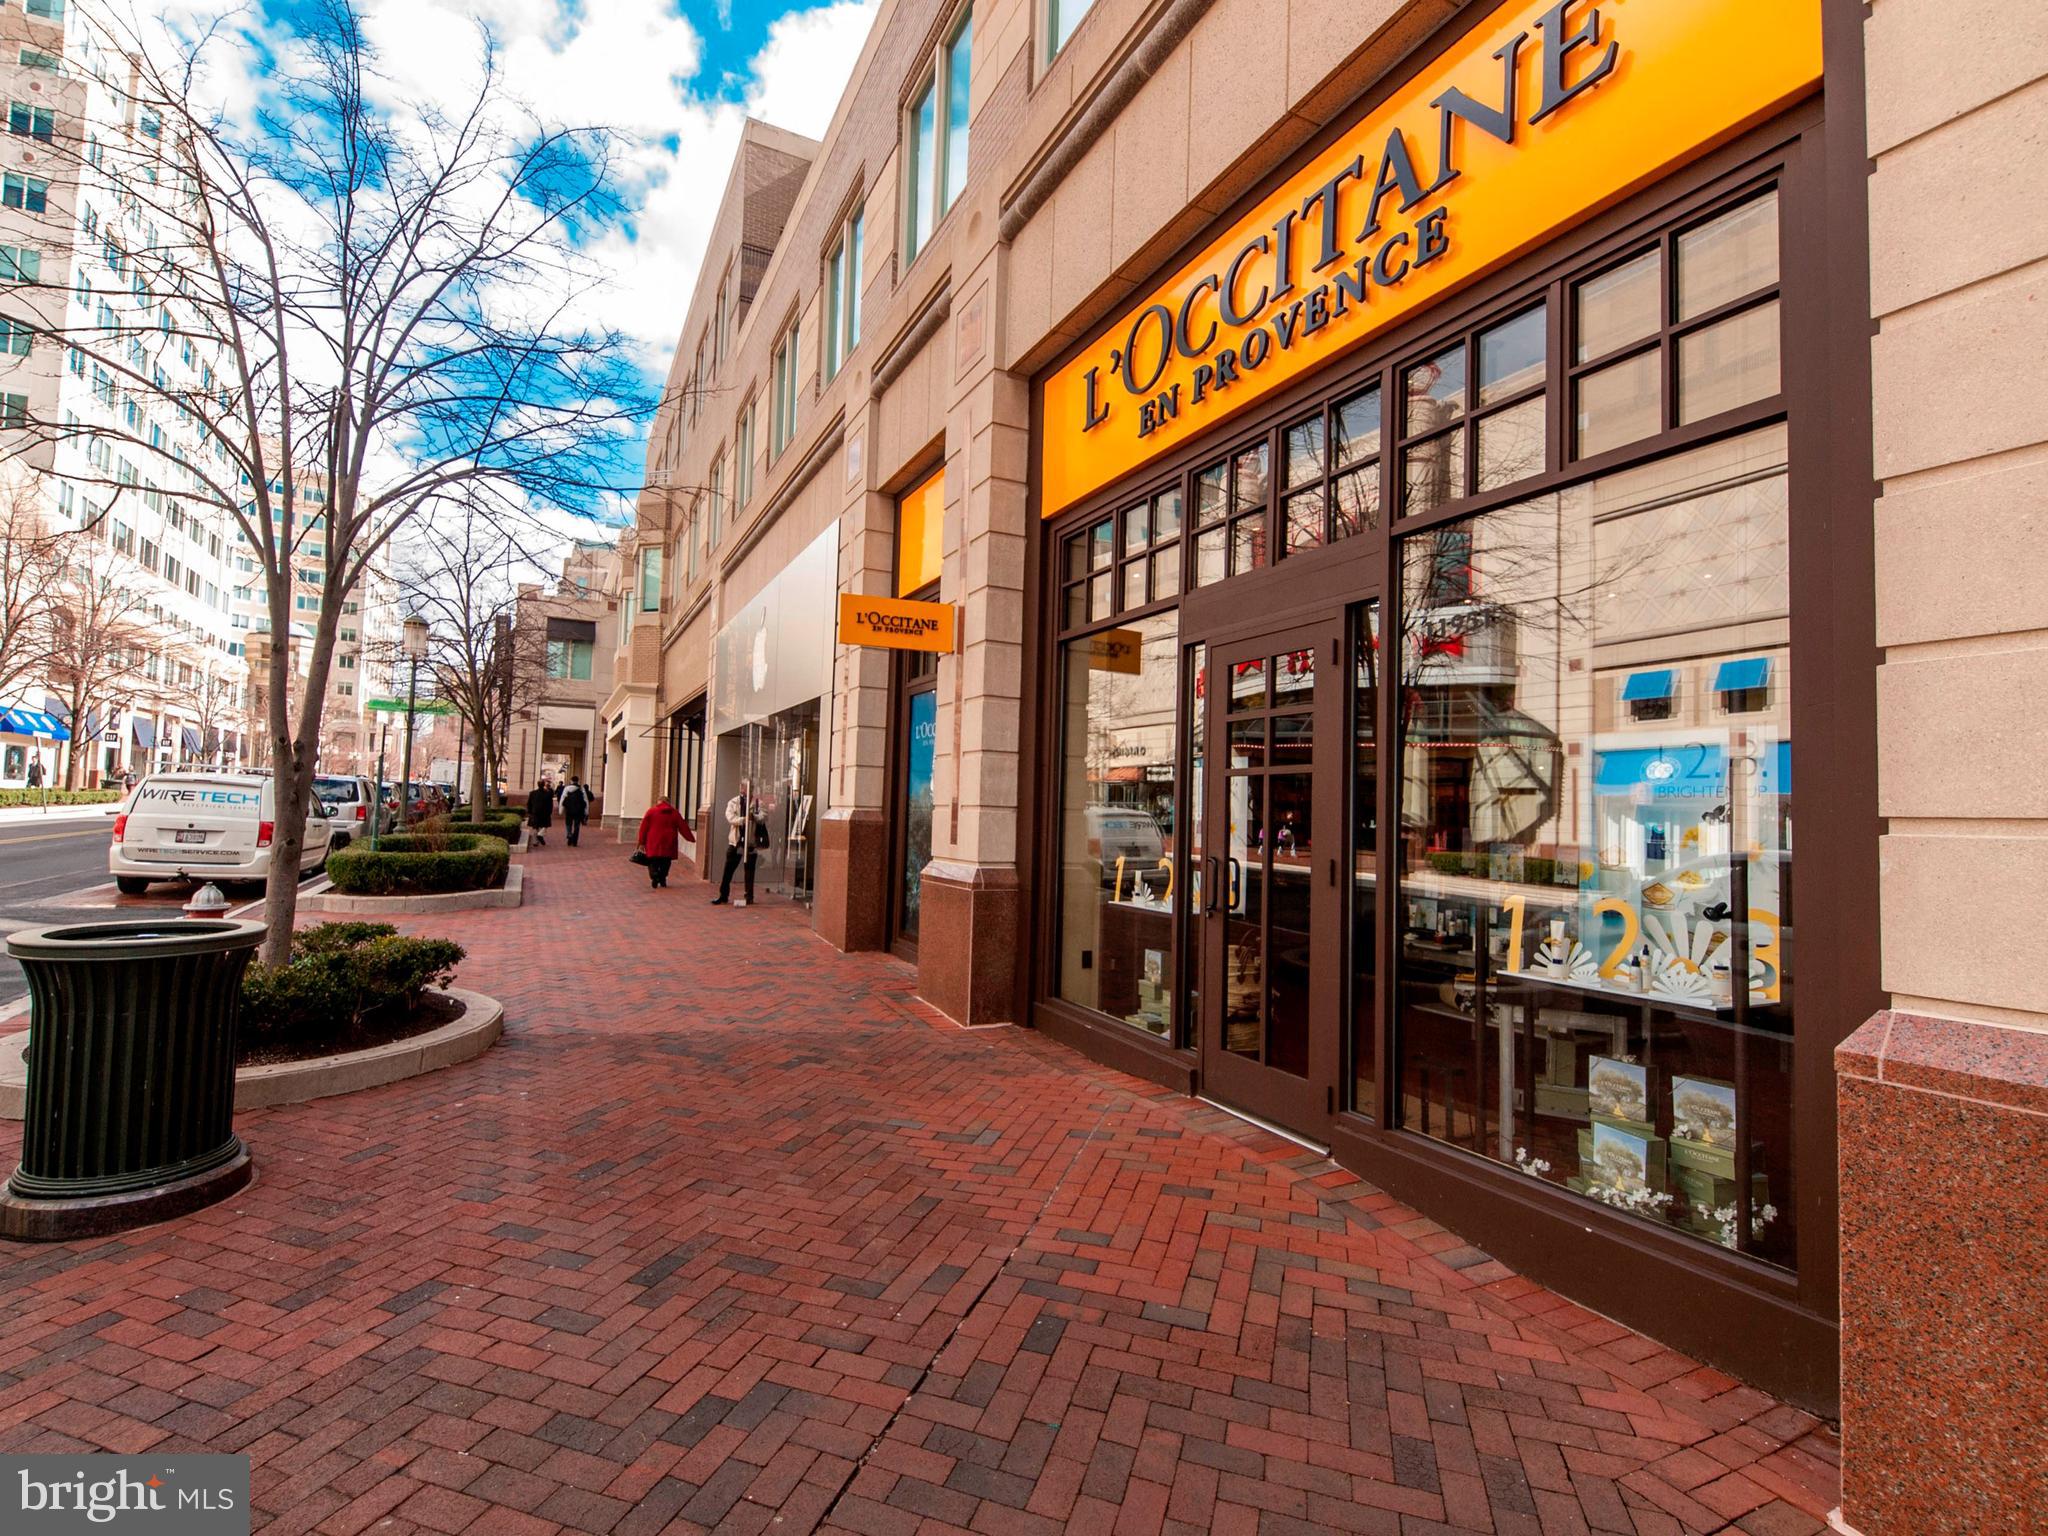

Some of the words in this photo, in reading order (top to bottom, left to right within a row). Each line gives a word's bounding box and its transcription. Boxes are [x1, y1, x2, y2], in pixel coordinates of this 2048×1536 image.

[1082, 0, 1620, 432] L'OCCITANE
[1137, 383, 1180, 438] EN
[1191, 206, 1449, 406] PROVENCE
[857, 611, 938, 631] L'OCCITANE
[885, 626, 923, 635] PROVENCE
